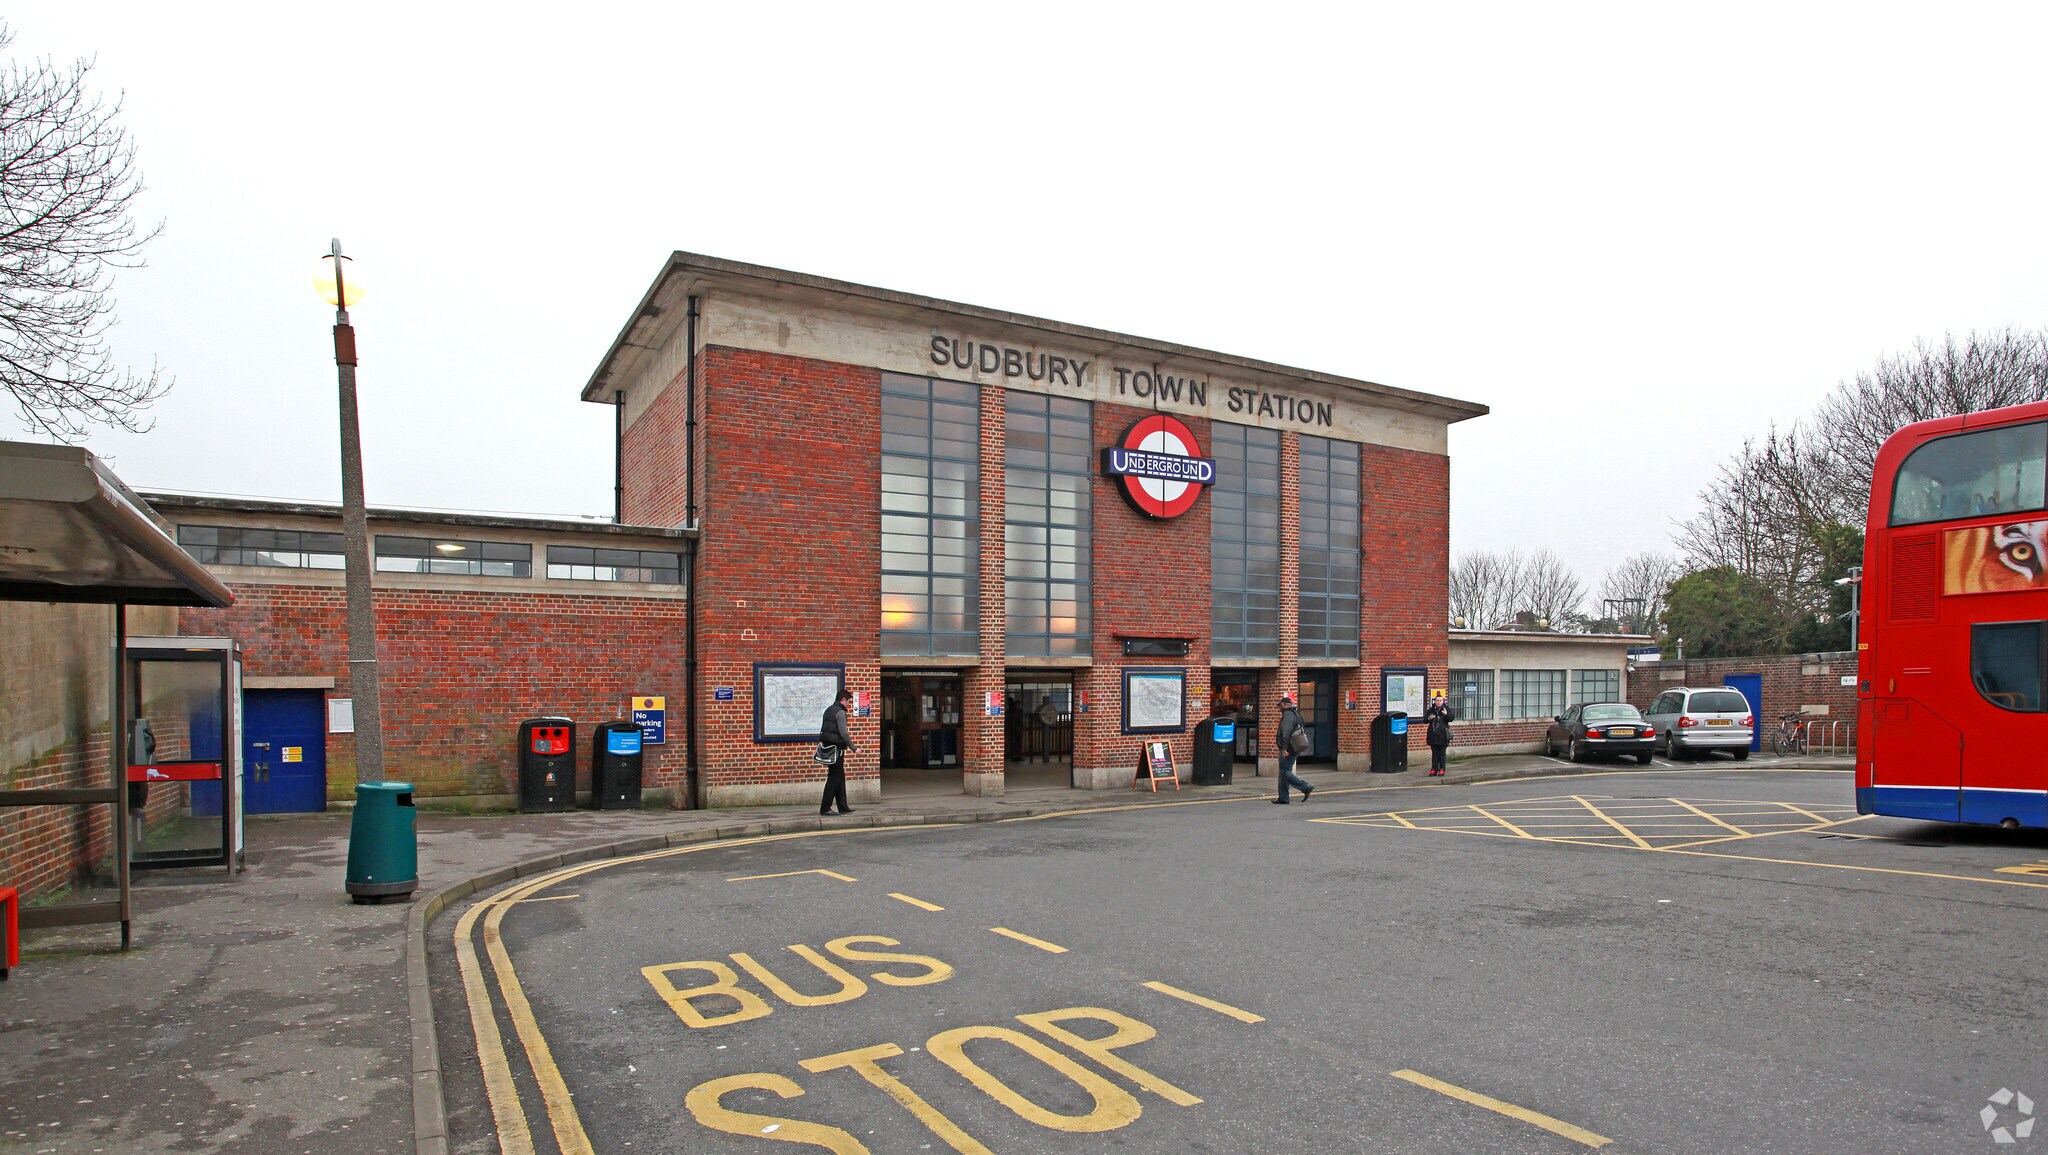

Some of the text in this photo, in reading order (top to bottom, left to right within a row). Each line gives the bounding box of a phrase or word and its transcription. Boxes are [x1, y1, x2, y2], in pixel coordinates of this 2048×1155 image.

[930, 335, 1333, 427] SUDBURY TOWN STATION
[1113, 450, 1212, 481] UNDERGROUND
[640, 934, 955, 1028] BUS
[684, 1005, 1204, 1155] STOP
